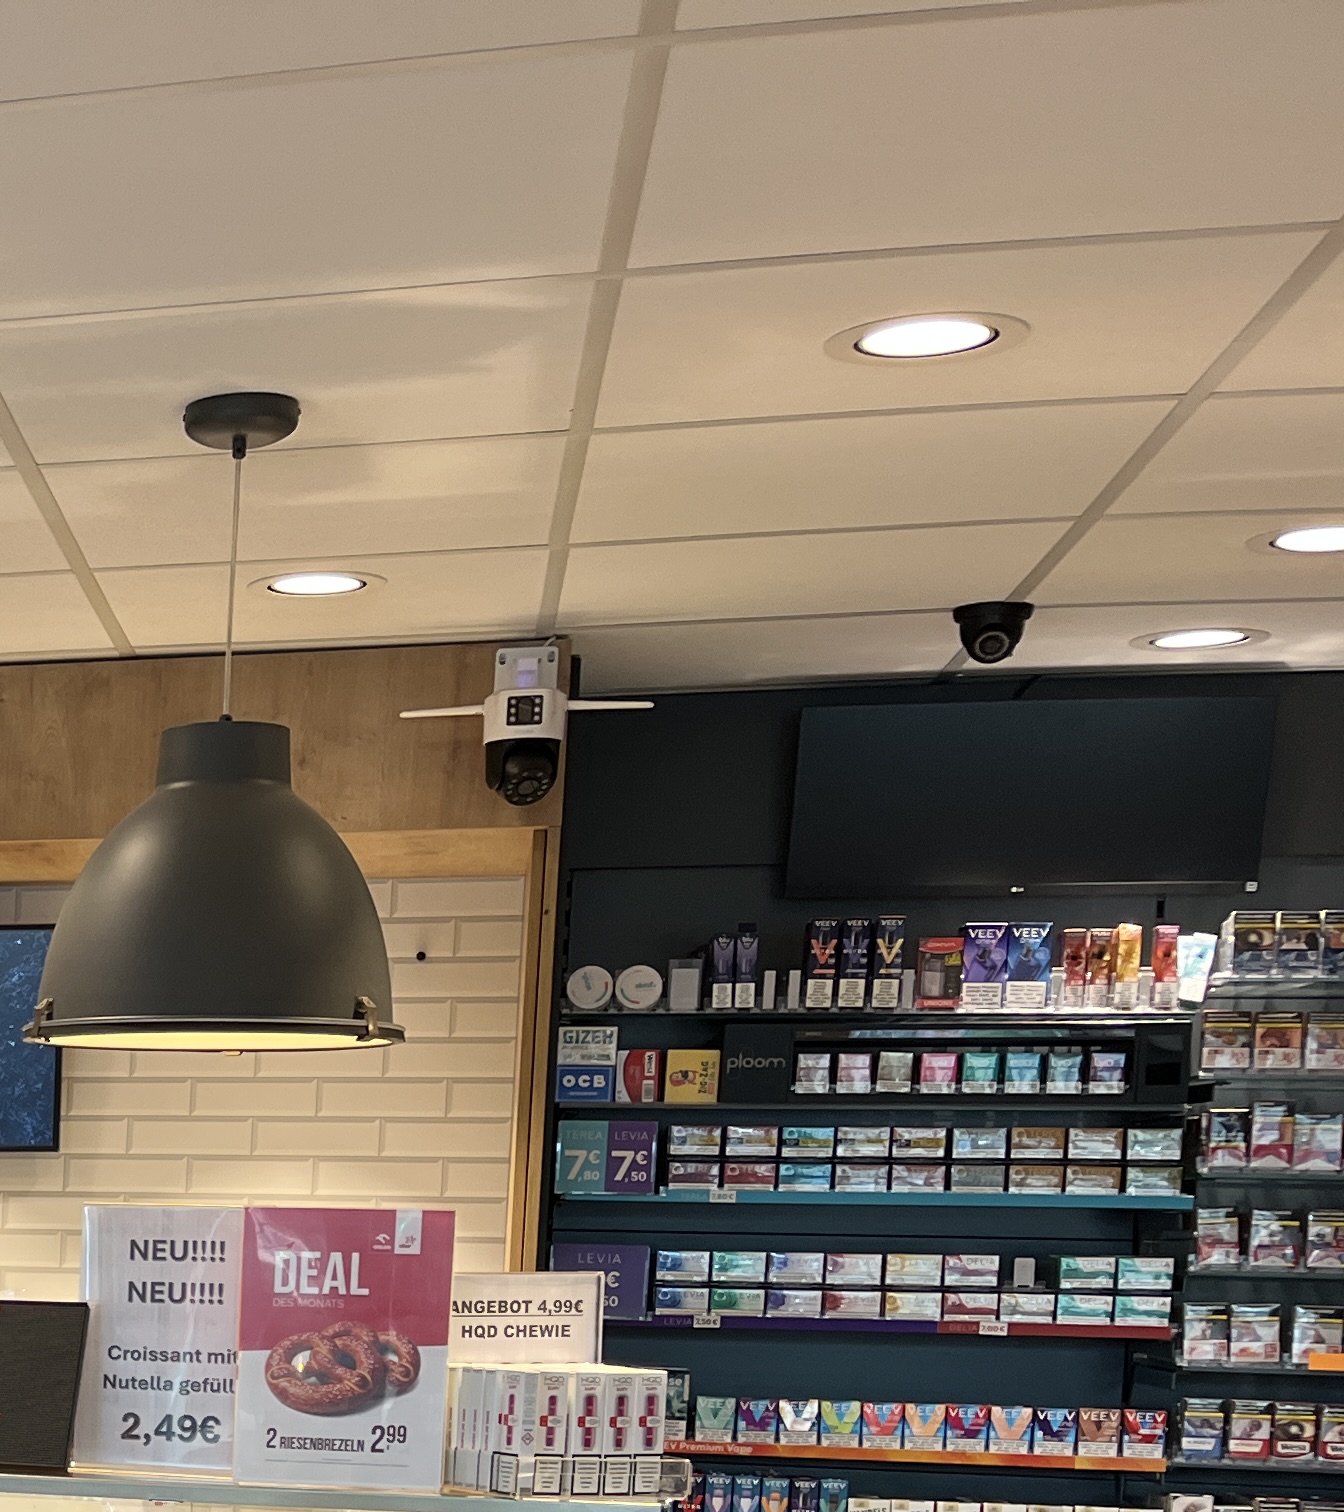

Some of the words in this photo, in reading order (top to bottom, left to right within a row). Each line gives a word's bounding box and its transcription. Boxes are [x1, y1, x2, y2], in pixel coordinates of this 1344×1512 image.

[726, 1050, 786, 1074] ploom
[562, 1074, 607, 1089] OCB
[613, 1130, 650, 1141] LEVIA
[128, 1238, 226, 1262] NEU!!!!
[578, 1253, 622, 1264] LEVIA
[273, 1250, 370, 1297] DEAL
[127, 1280, 225, 1306] NEU!!!!
[272, 1297, 294, 1309] DES
[452, 1299, 532, 1314] ANGEBOT
[537, 1299, 584, 1316] 4,99€
[461, 1325, 498, 1340] HQD
[503, 1325, 572, 1338] CHEWIE
[107, 1344, 202, 1364] Croissant
[102, 1373, 174, 1392] Nutella
[179, 1376, 237, 1397] gefüll
[120, 1411, 222, 1447] 2,49€
[265, 1427, 277, 1449] 2
[279, 1435, 365, 1453] RIESENBREZELN
[679, 1441, 724, 1454] Premium
